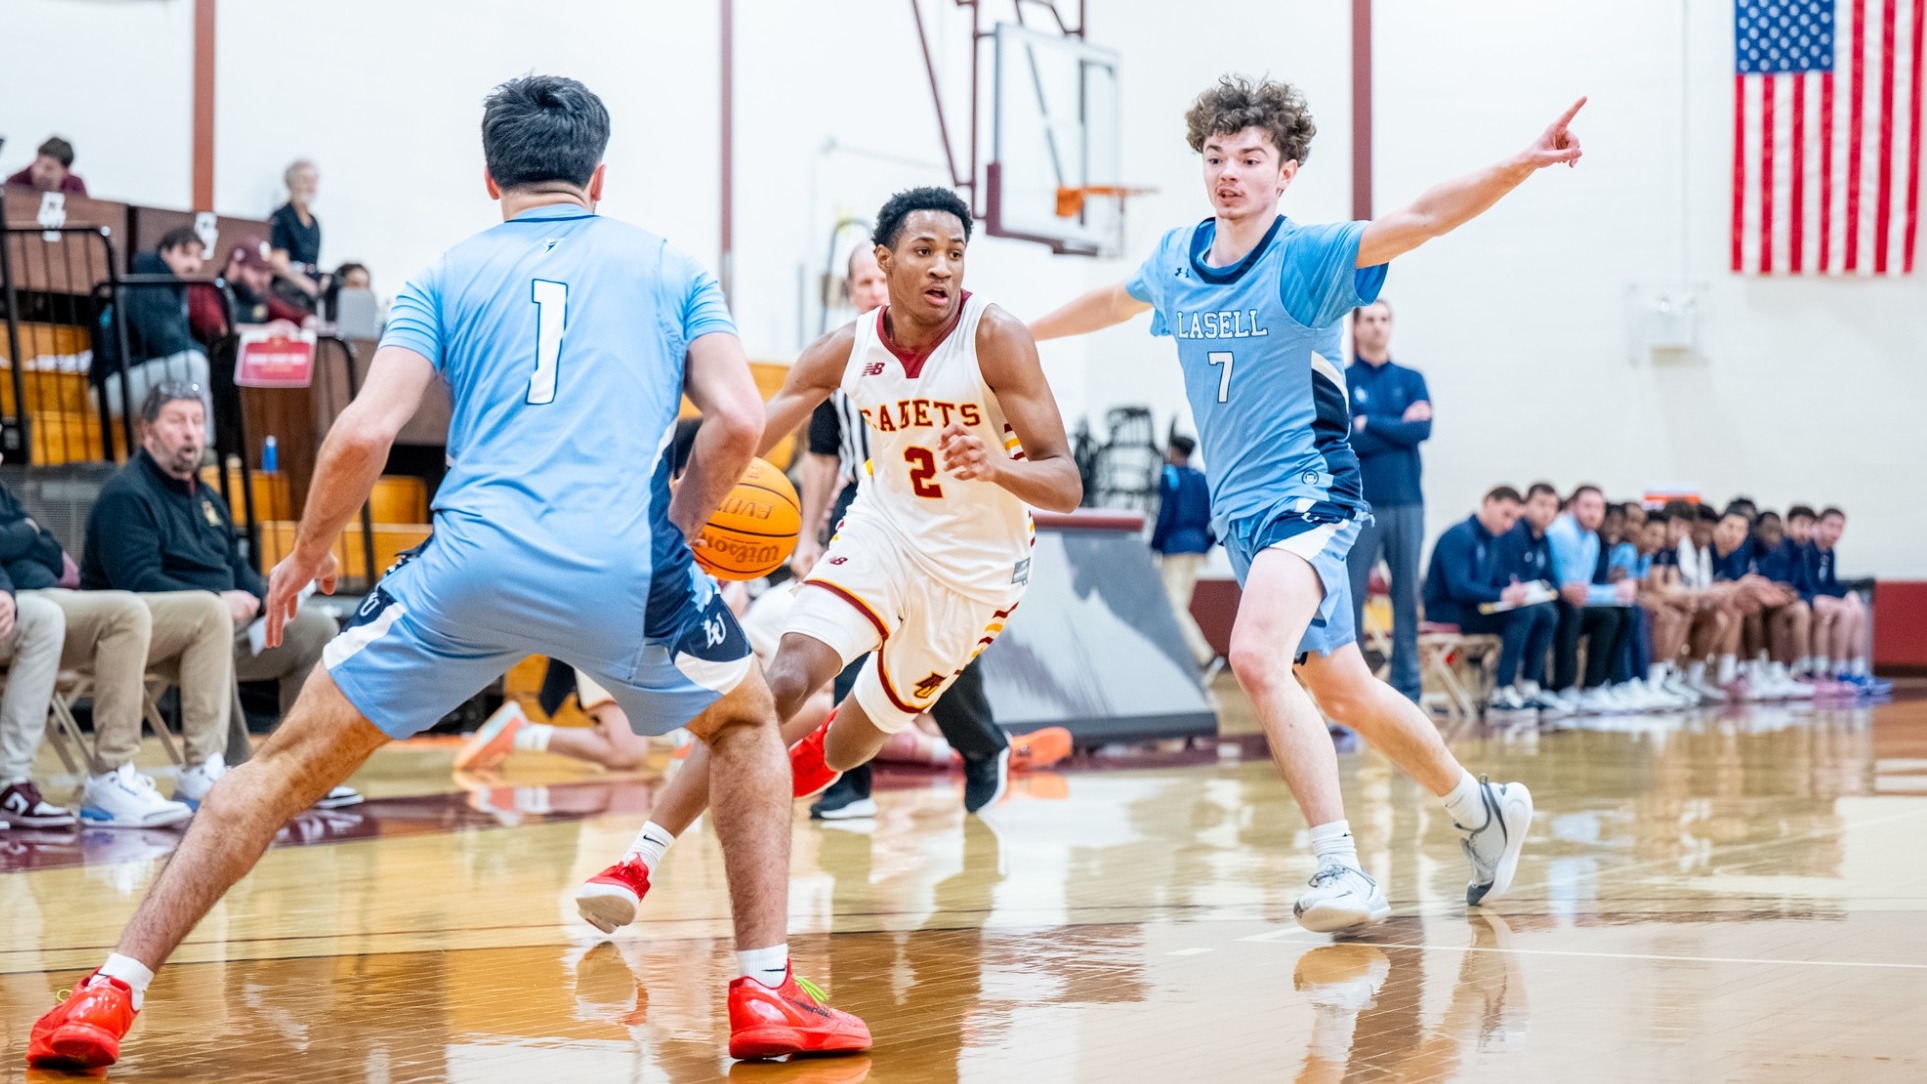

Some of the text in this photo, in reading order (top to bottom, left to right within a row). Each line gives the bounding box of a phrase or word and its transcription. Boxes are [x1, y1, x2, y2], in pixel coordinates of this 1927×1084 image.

[525, 278, 569, 406] 1
[1177, 309, 1268, 339] LASELL
[1208, 351, 1234, 404] 7
[904, 445, 944, 499] 2
